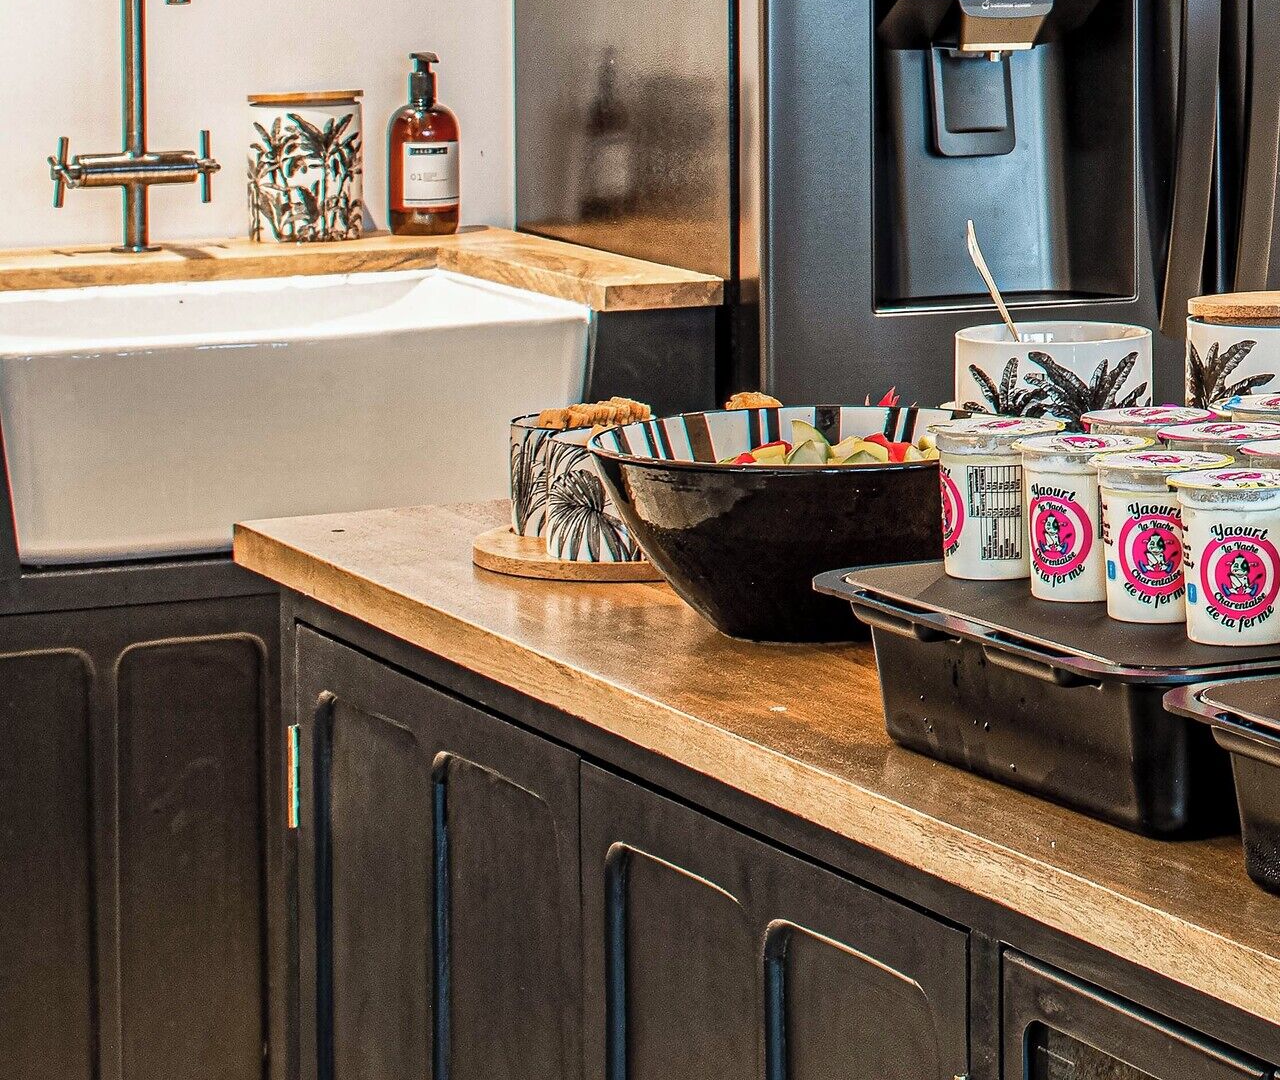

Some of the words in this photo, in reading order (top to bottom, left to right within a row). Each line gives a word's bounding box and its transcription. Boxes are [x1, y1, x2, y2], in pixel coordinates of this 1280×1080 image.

[1031, 483, 1076, 502] Yaourt
[1046, 501, 1067, 515] Vache
[1137, 523, 1149, 532] La
[1149, 520, 1175, 532] Vache
[1210, 523, 1269, 541] Yaourt
[1035, 547, 1077, 567] Charentaise
[1221, 544, 1233, 554] La
[1233, 541, 1260, 554] Vache
[1040, 570, 1051, 583] la
[1051, 563, 1086, 588] ferme
[1131, 568, 1183, 586] Charentaise
[1124, 581, 1137, 597] de
[1138, 591, 1152, 605] la
[1154, 585, 1185, 609] ferm
[1214, 591, 1267, 610] Charentaise
[1206, 604, 1221, 621] de
[1221, 613, 1236, 629] la
[1237, 605, 1275, 633] ferme
